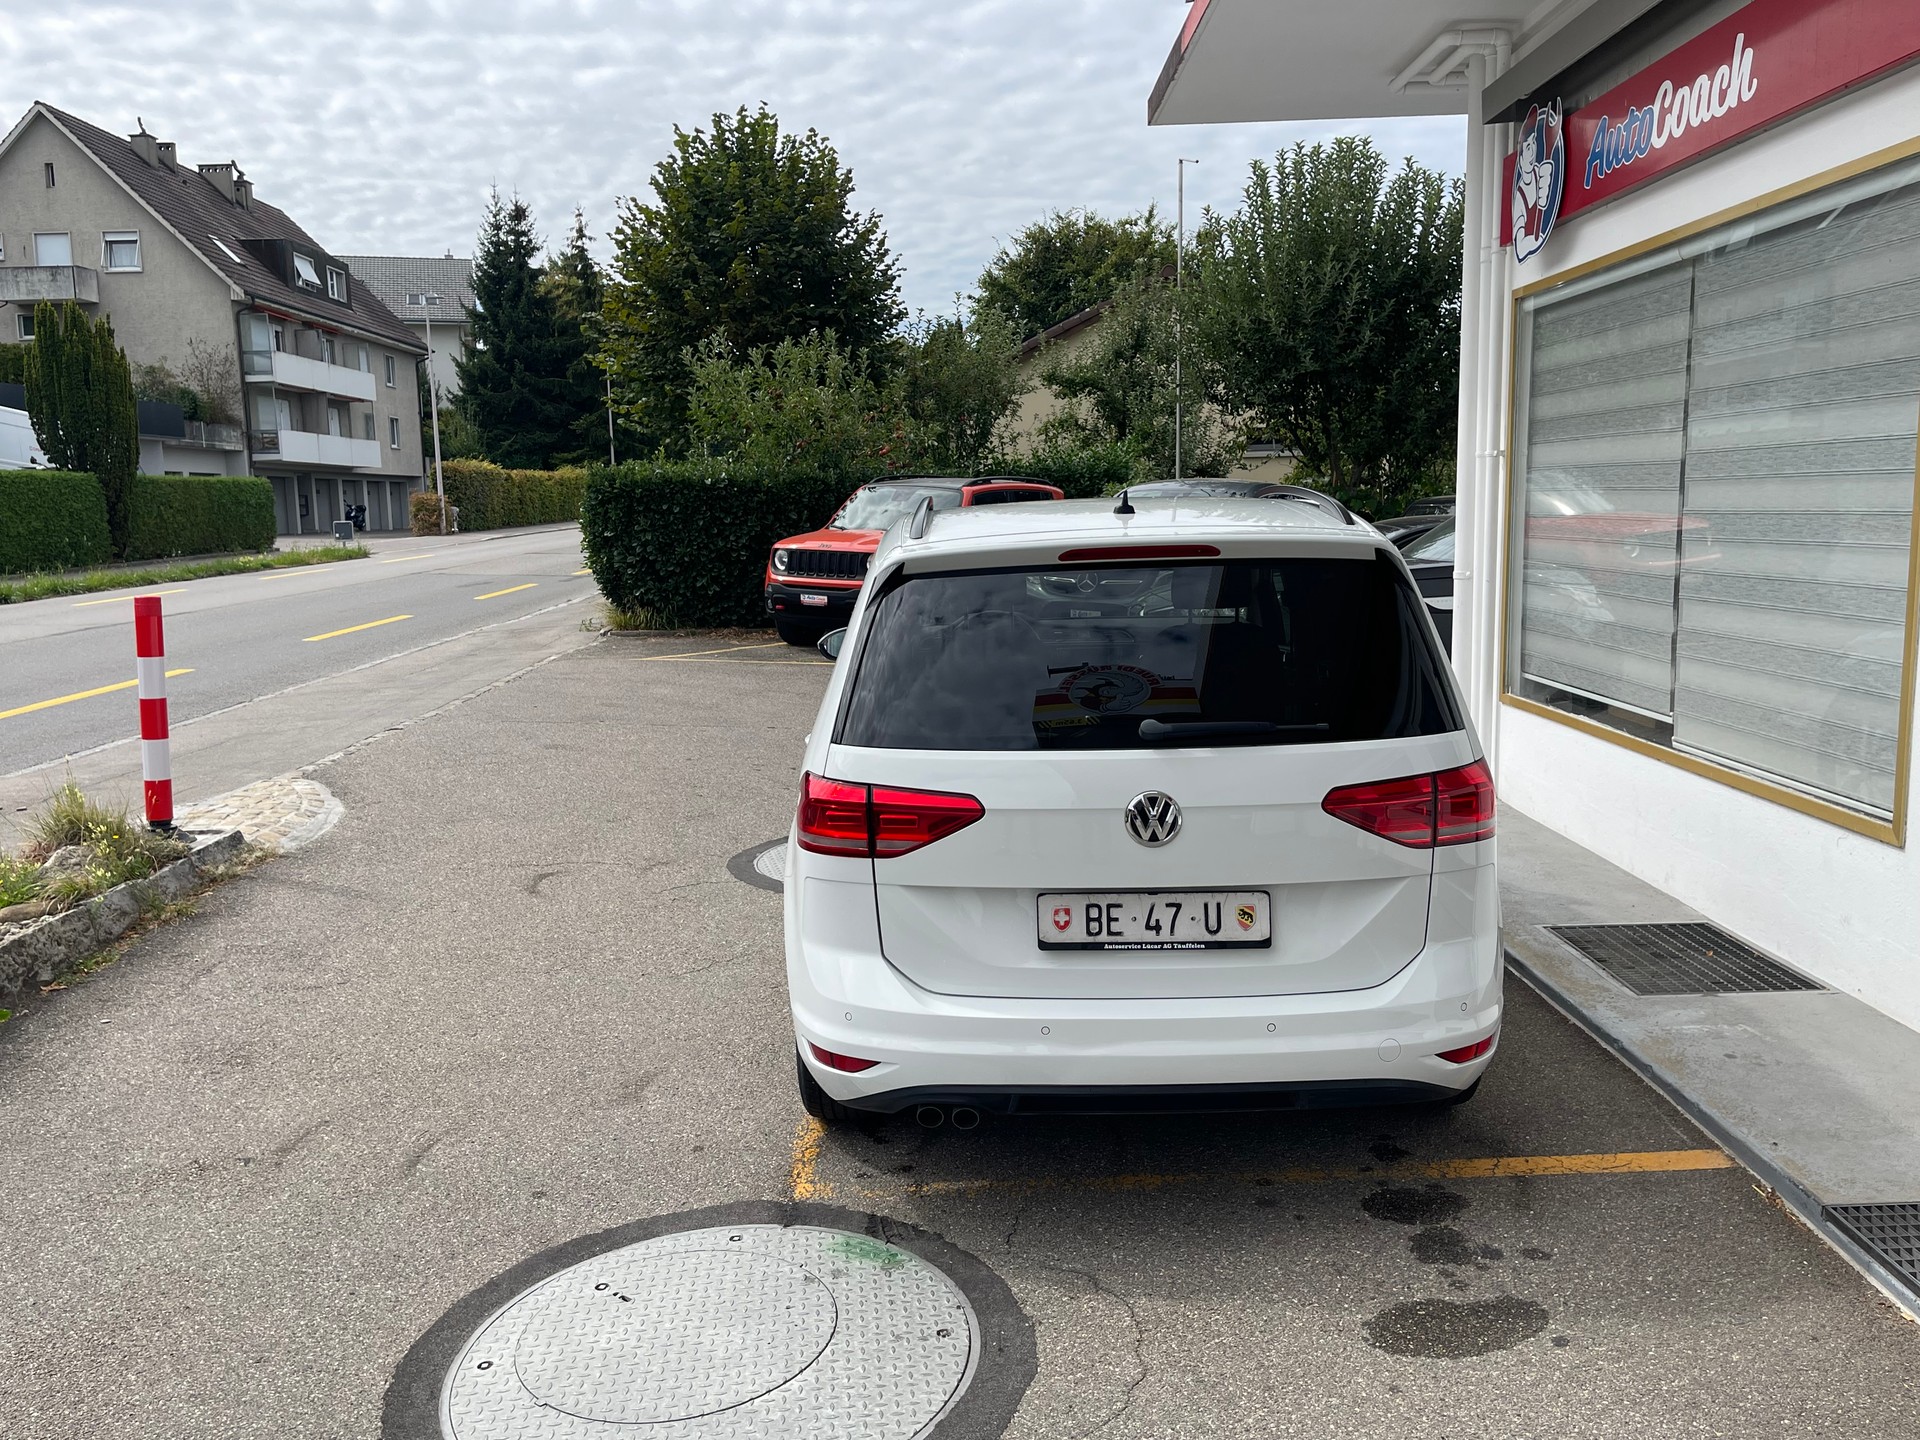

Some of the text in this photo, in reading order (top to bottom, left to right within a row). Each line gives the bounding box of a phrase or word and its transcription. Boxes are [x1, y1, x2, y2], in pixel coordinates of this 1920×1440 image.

[1584, 32, 1758, 189] AutoCoach
[1085, 901, 1222, 937] BE 47 U
